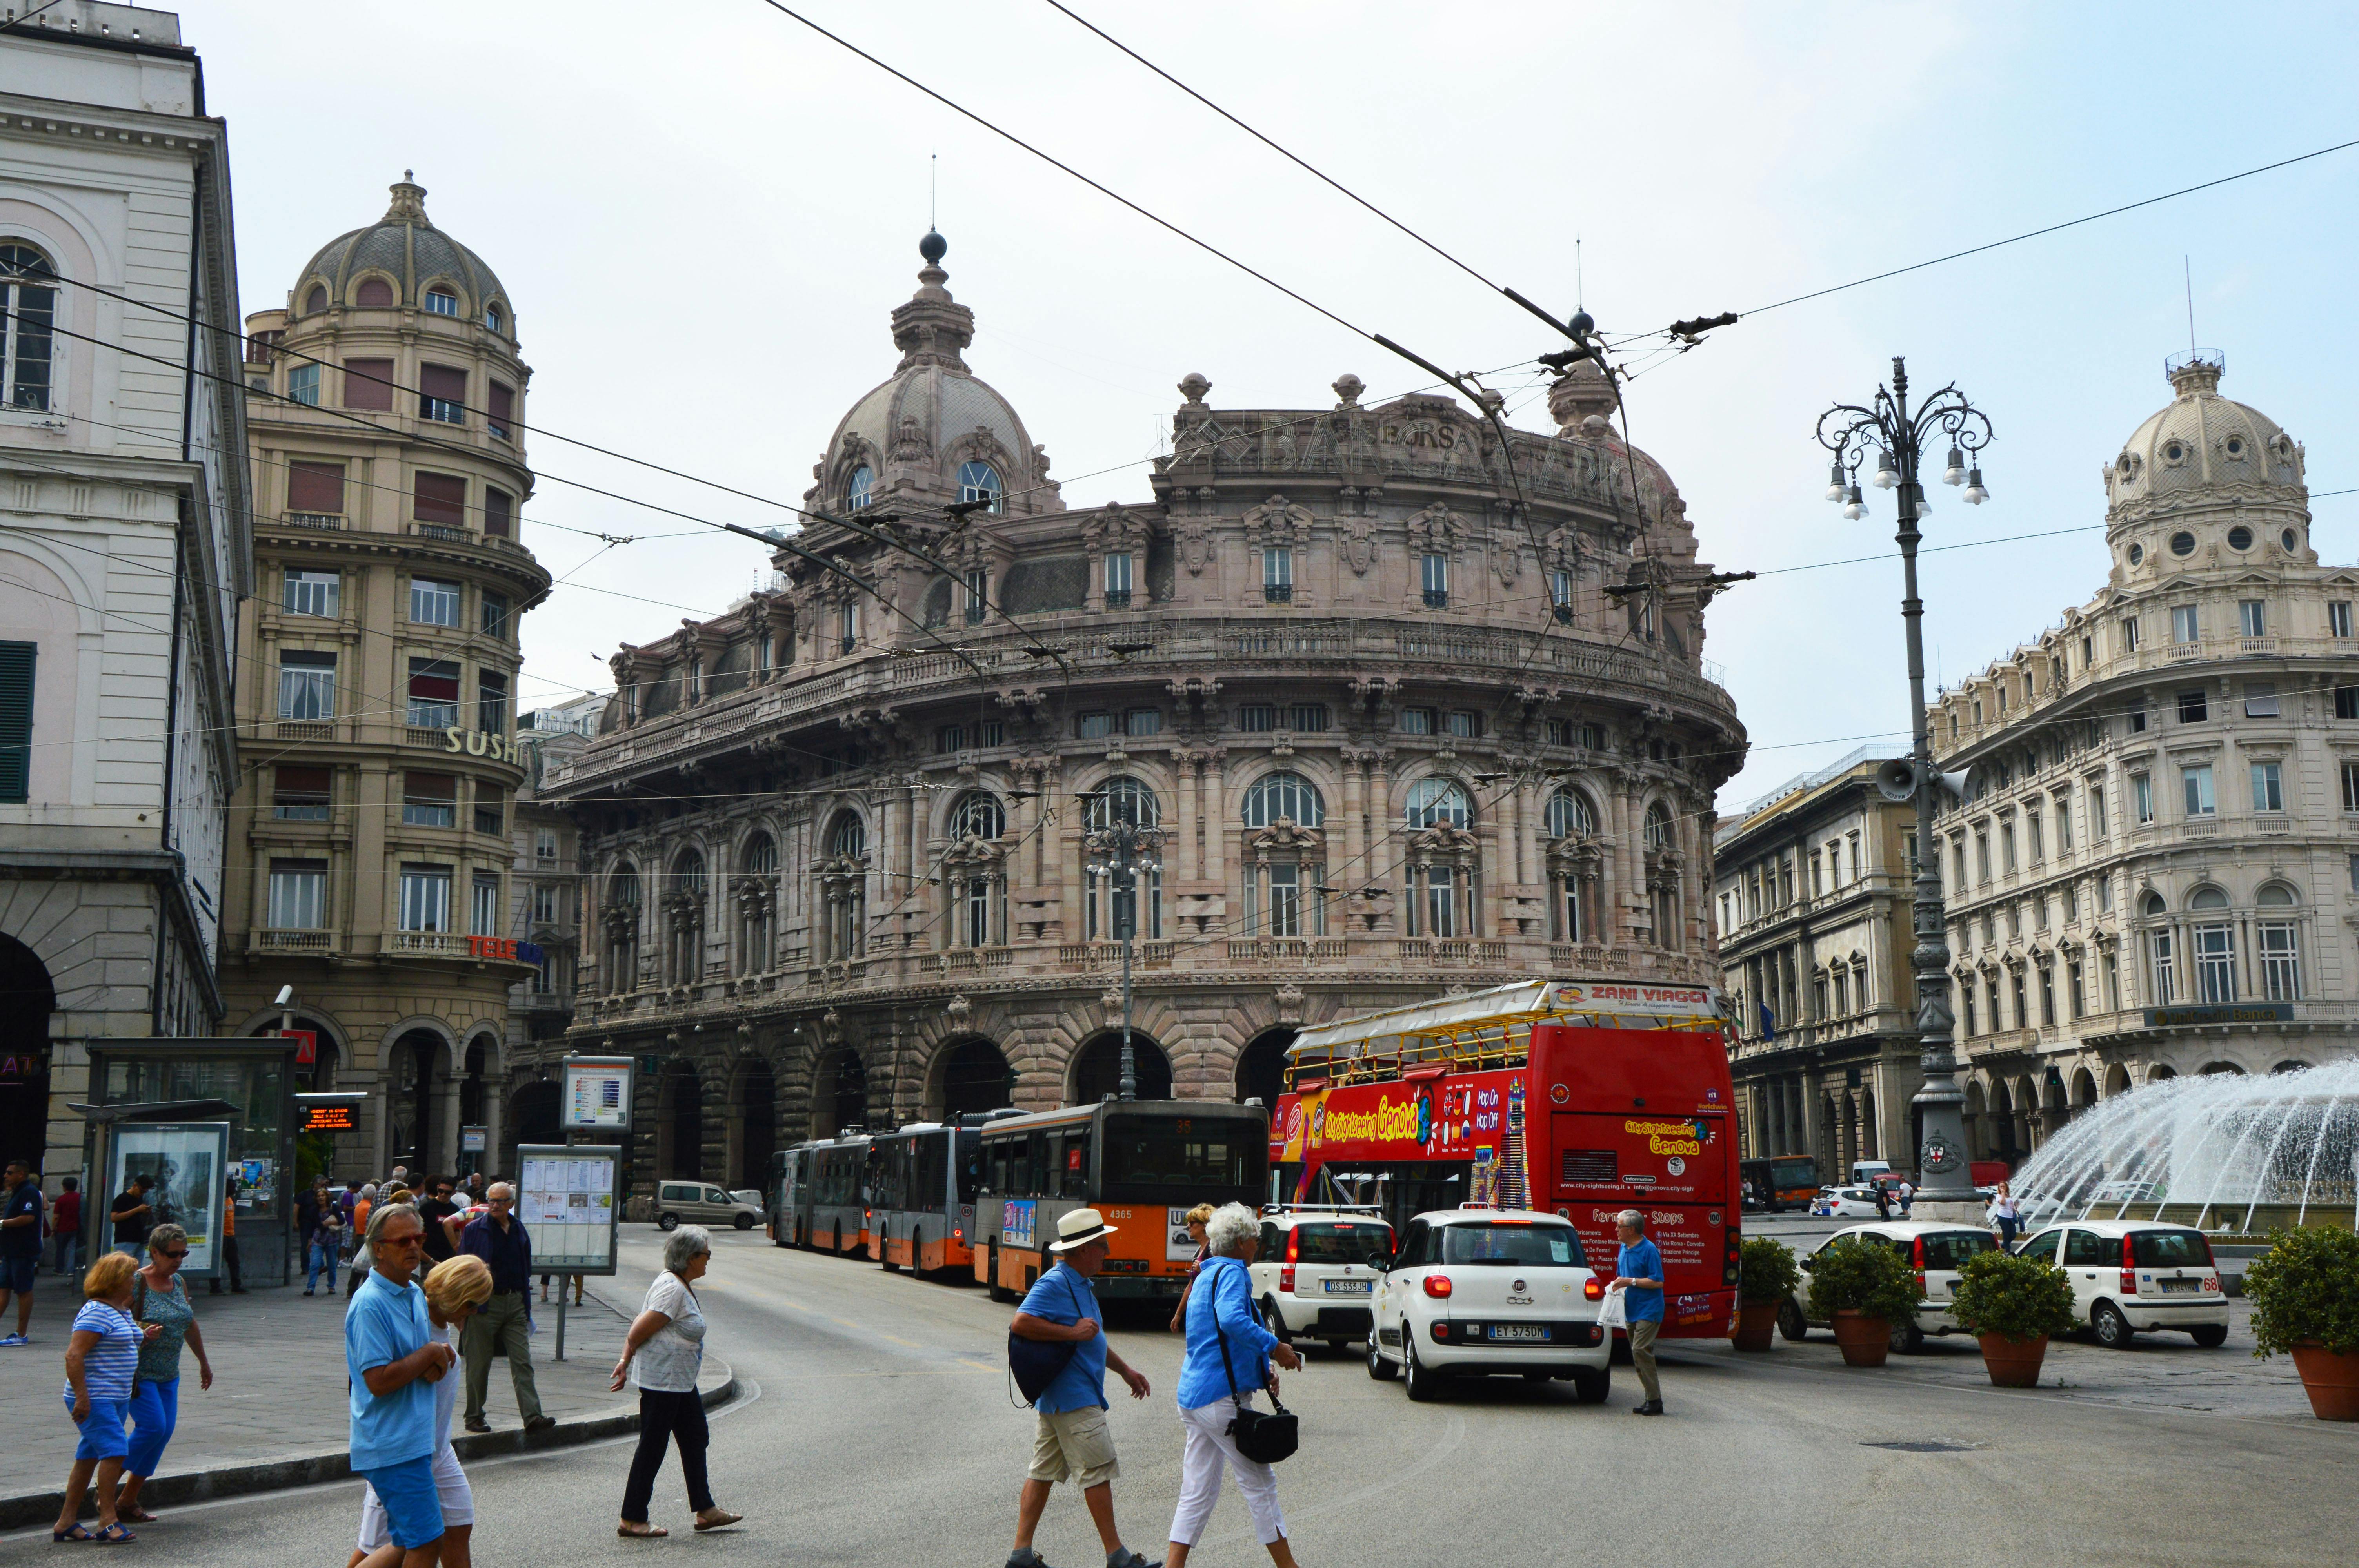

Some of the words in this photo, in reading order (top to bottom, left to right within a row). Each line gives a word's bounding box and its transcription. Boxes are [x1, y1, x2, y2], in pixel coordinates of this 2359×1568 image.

[1262, 413, 1488, 484] BANCA
[445, 726, 523, 766] SUSHI
[1885, 790, 1905, 799] MARCHI
[1591, 986, 1638, 1000] ZANI
[1641, 988, 1708, 1004] VIAGGI
[2171, 1010, 2230, 1024] UniCredit
[2232, 1009, 2277, 1021] Banca
[1892, 1042, 1921, 1050] BANC
[1478, 1091, 1489, 1108] Hop
[1490, 1089, 1498, 1106] On
[1325, 1110, 1377, 1142] CitySightseeing
[1378, 1095, 1419, 1141] Genova
[1477, 1113, 1488, 1130] Hop
[1489, 1112, 1498, 1128] Off
[1177, 1120, 1191, 1134] 35
[1625, 1120, 1696, 1137] CitySightseeing
[1650, 1135, 1700, 1155] Genova
[1110, 1210, 1132, 1219] 4365
[1593, 1209, 1619, 1223] Ferm
[1651, 1211, 1684, 1225] Stops
[1343, 1282, 1367, 1290] 533JH
[2166, 1283, 2175, 1292] EK
[2204, 1278, 2217, 1291] 68
[1496, 1327, 1508, 1336] EY
[1512, 1327, 1543, 1338] 373DM
